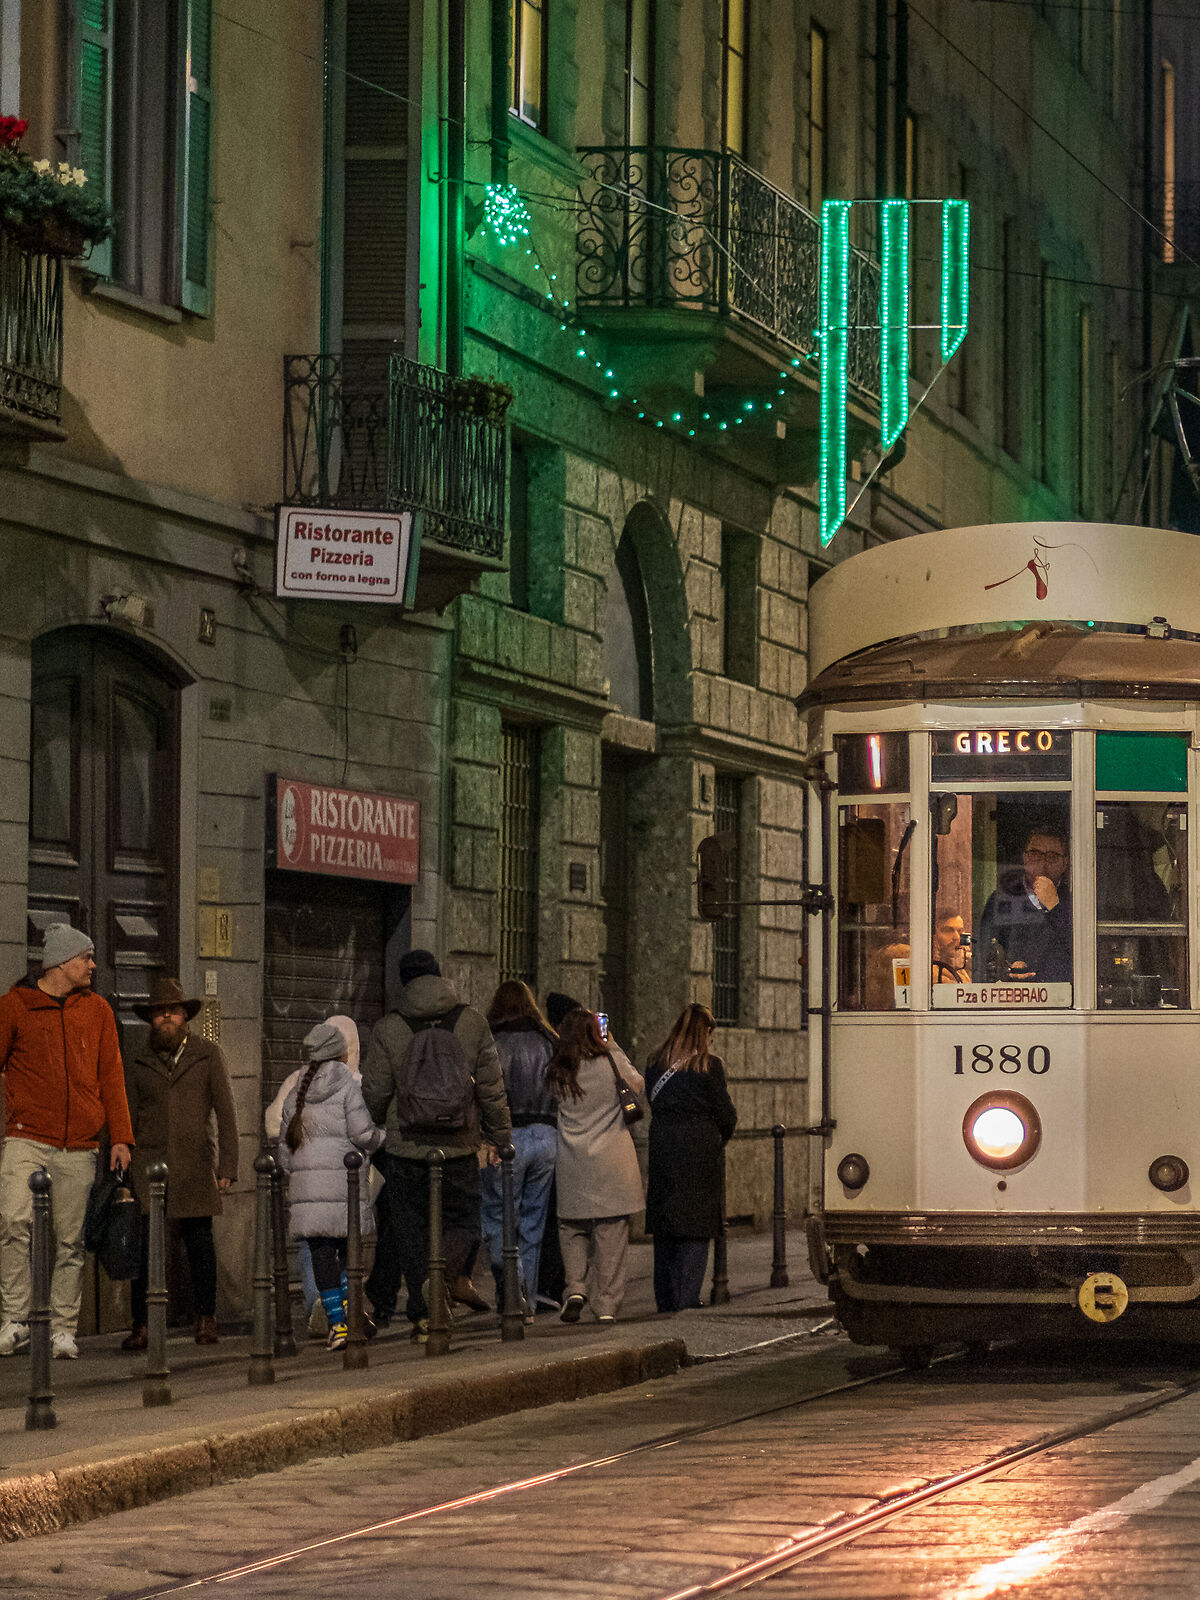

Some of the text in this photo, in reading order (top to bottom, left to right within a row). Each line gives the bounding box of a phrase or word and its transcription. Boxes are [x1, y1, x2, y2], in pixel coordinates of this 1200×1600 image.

[294, 521, 394, 545] Ristorante
[310, 547, 374, 566] Pizzeria
[291, 571, 312, 580] con
[316, 571, 347, 583] forno
[358, 574, 390, 586] legna
[956, 731, 1052, 753] GRECO
[310, 789, 416, 840] RISTORANTE
[310, 833, 382, 871] PIZZERIA
[956, 987, 1048, 1003] P.za 6 FEBBRAIO
[953, 1044, 1051, 1075] 1880
